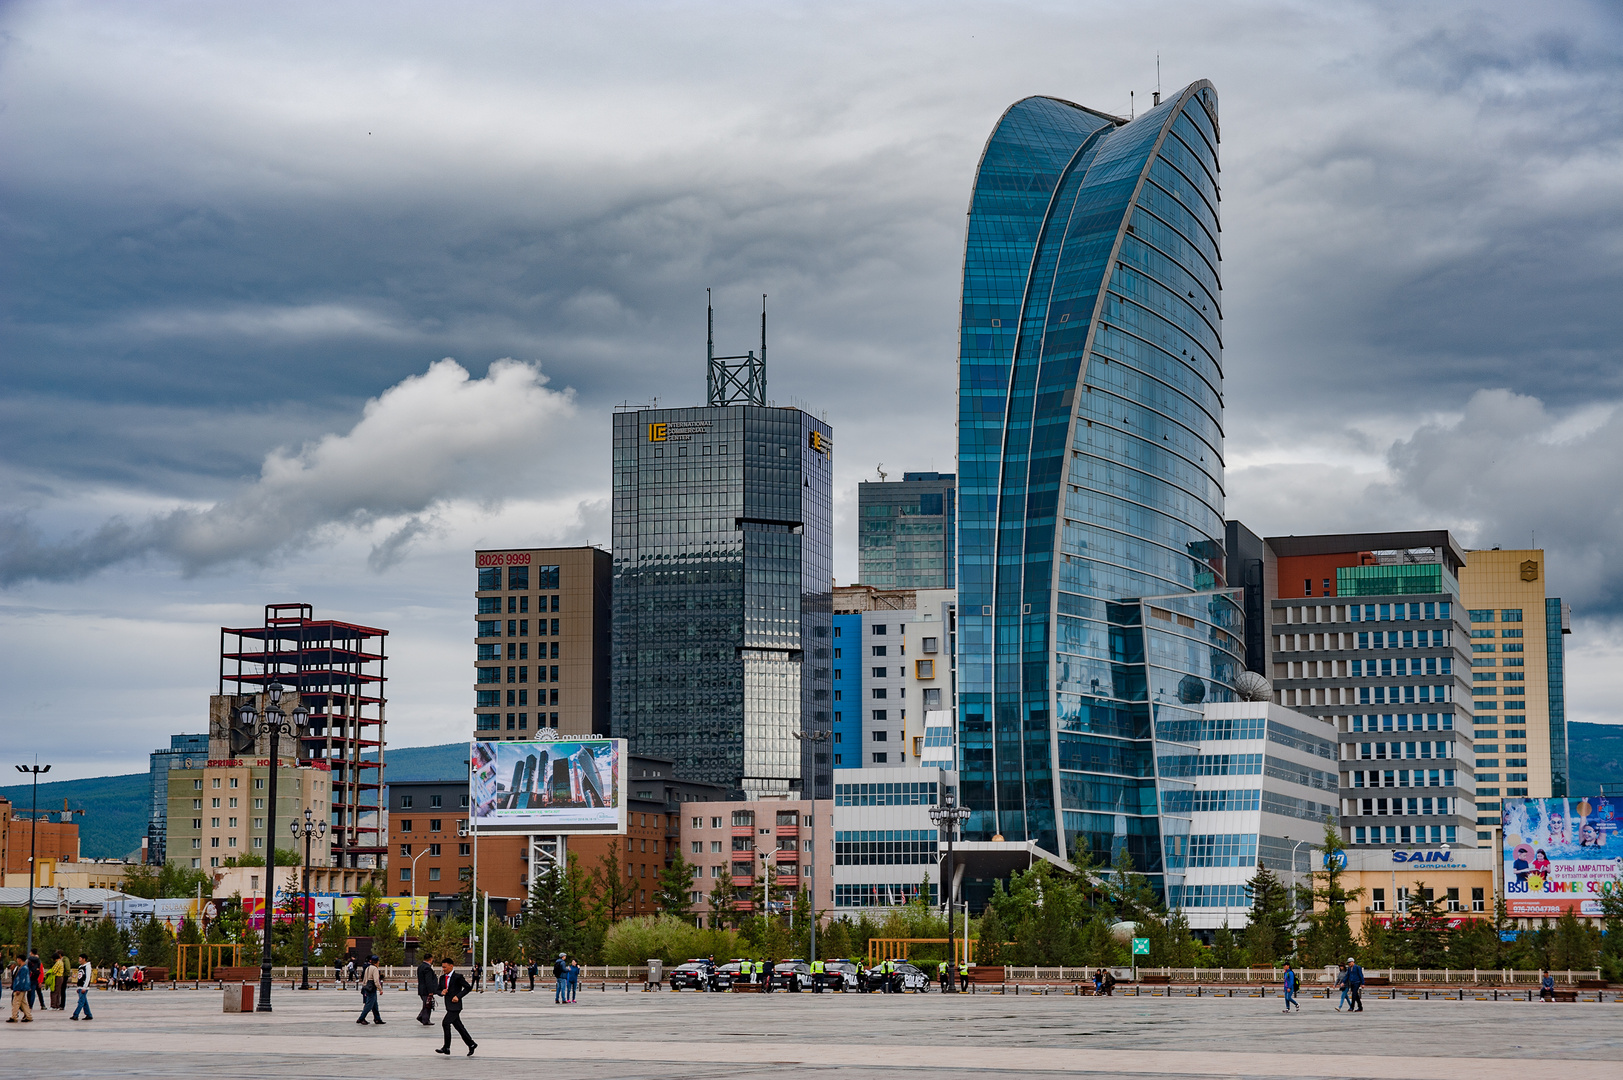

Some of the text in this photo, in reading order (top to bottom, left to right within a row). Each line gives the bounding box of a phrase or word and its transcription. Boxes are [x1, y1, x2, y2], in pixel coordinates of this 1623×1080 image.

[667, 421, 713, 429] INTERNATIONAL
[667, 427, 707, 435] COMMERCIAL
[479, 553, 531, 566] 8026 9999
[1392, 851, 1451, 862] SAIN
[1554, 864, 1616, 872] ЗУНЫ АМРАЛТЫГ
[1508, 881, 1529, 893] BSU
[1543, 881, 1583, 893] SUMMER
[904, 974, 925, 985] POLICE
